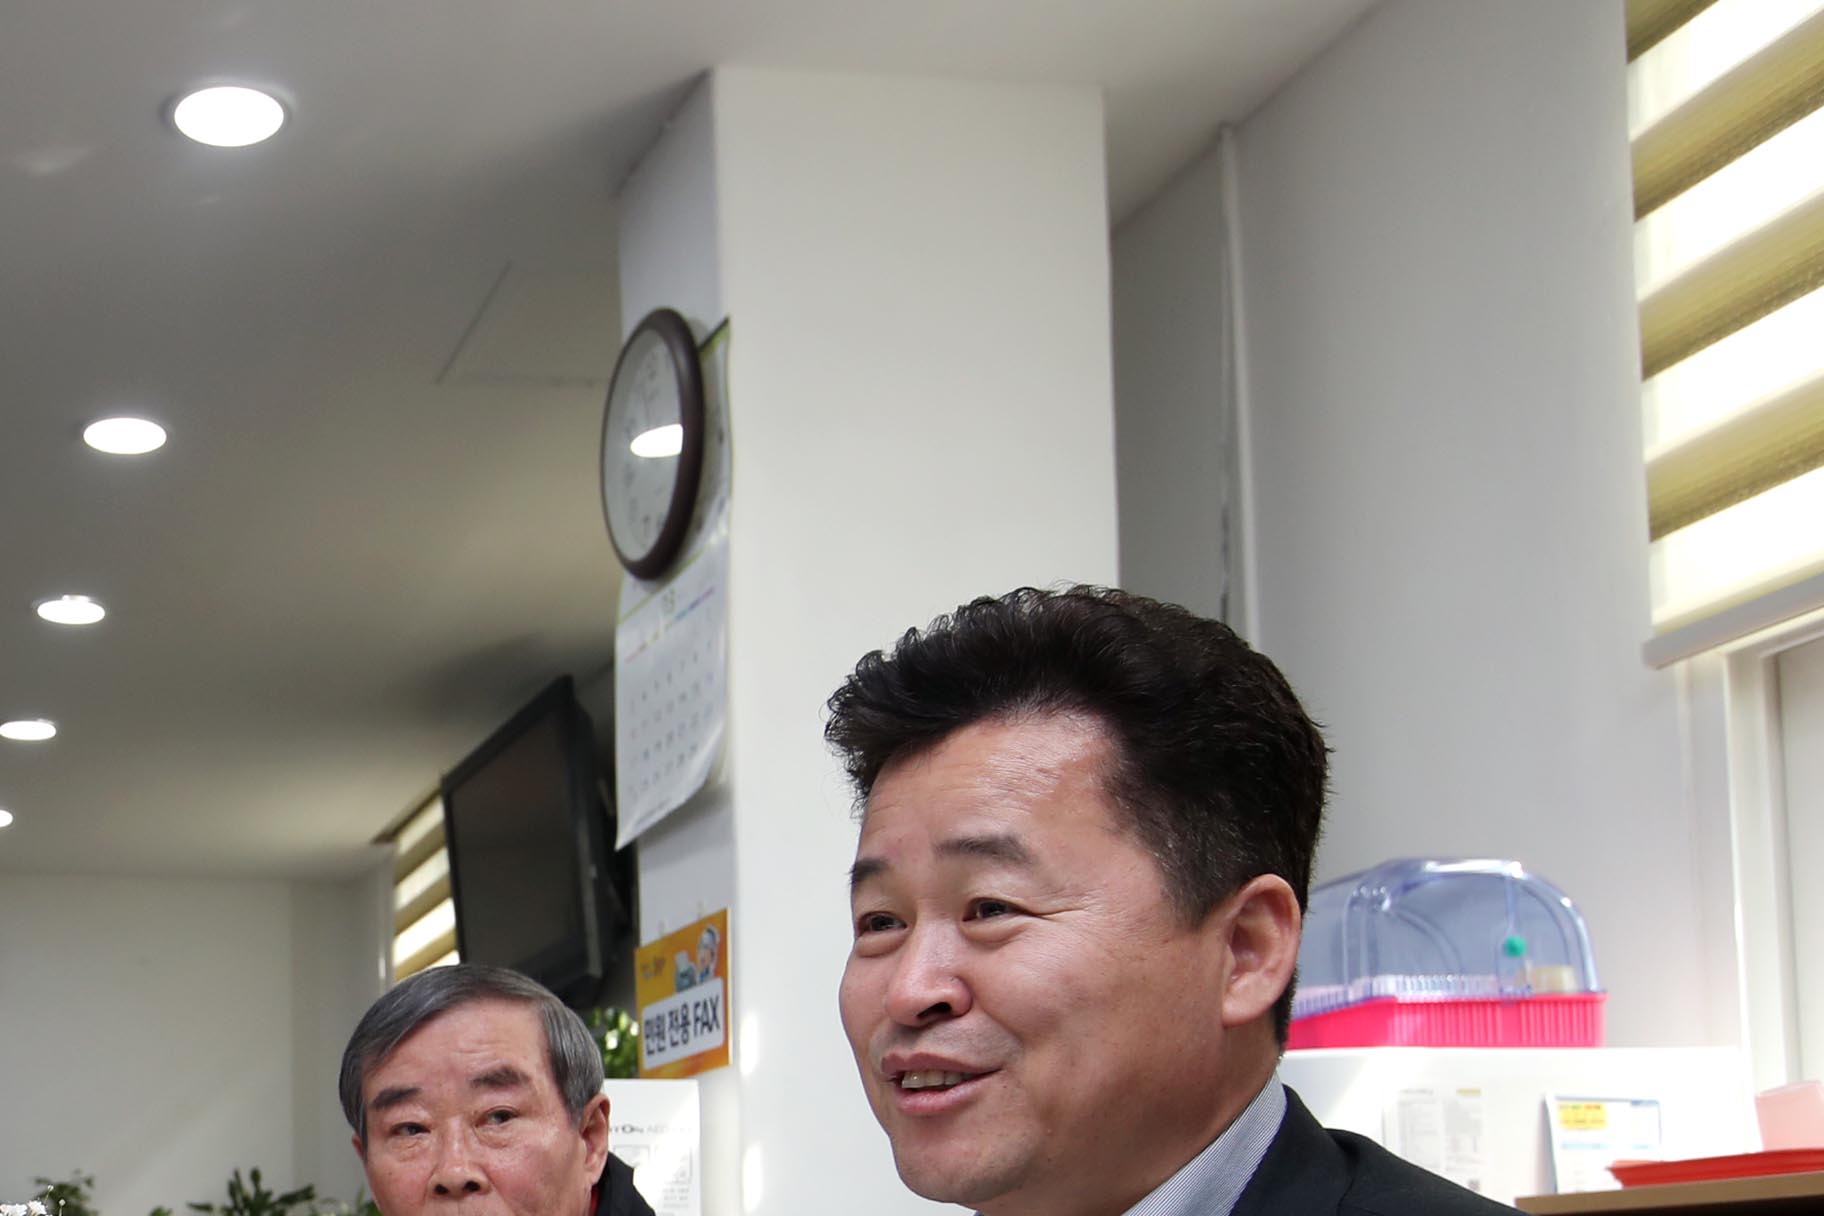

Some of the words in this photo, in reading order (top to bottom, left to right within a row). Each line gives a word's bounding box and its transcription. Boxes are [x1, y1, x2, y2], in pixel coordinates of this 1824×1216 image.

[645, 1013, 666, 1055] 민원
[669, 1002, 690, 1046] 전용
[694, 996, 720, 1037] FAX
